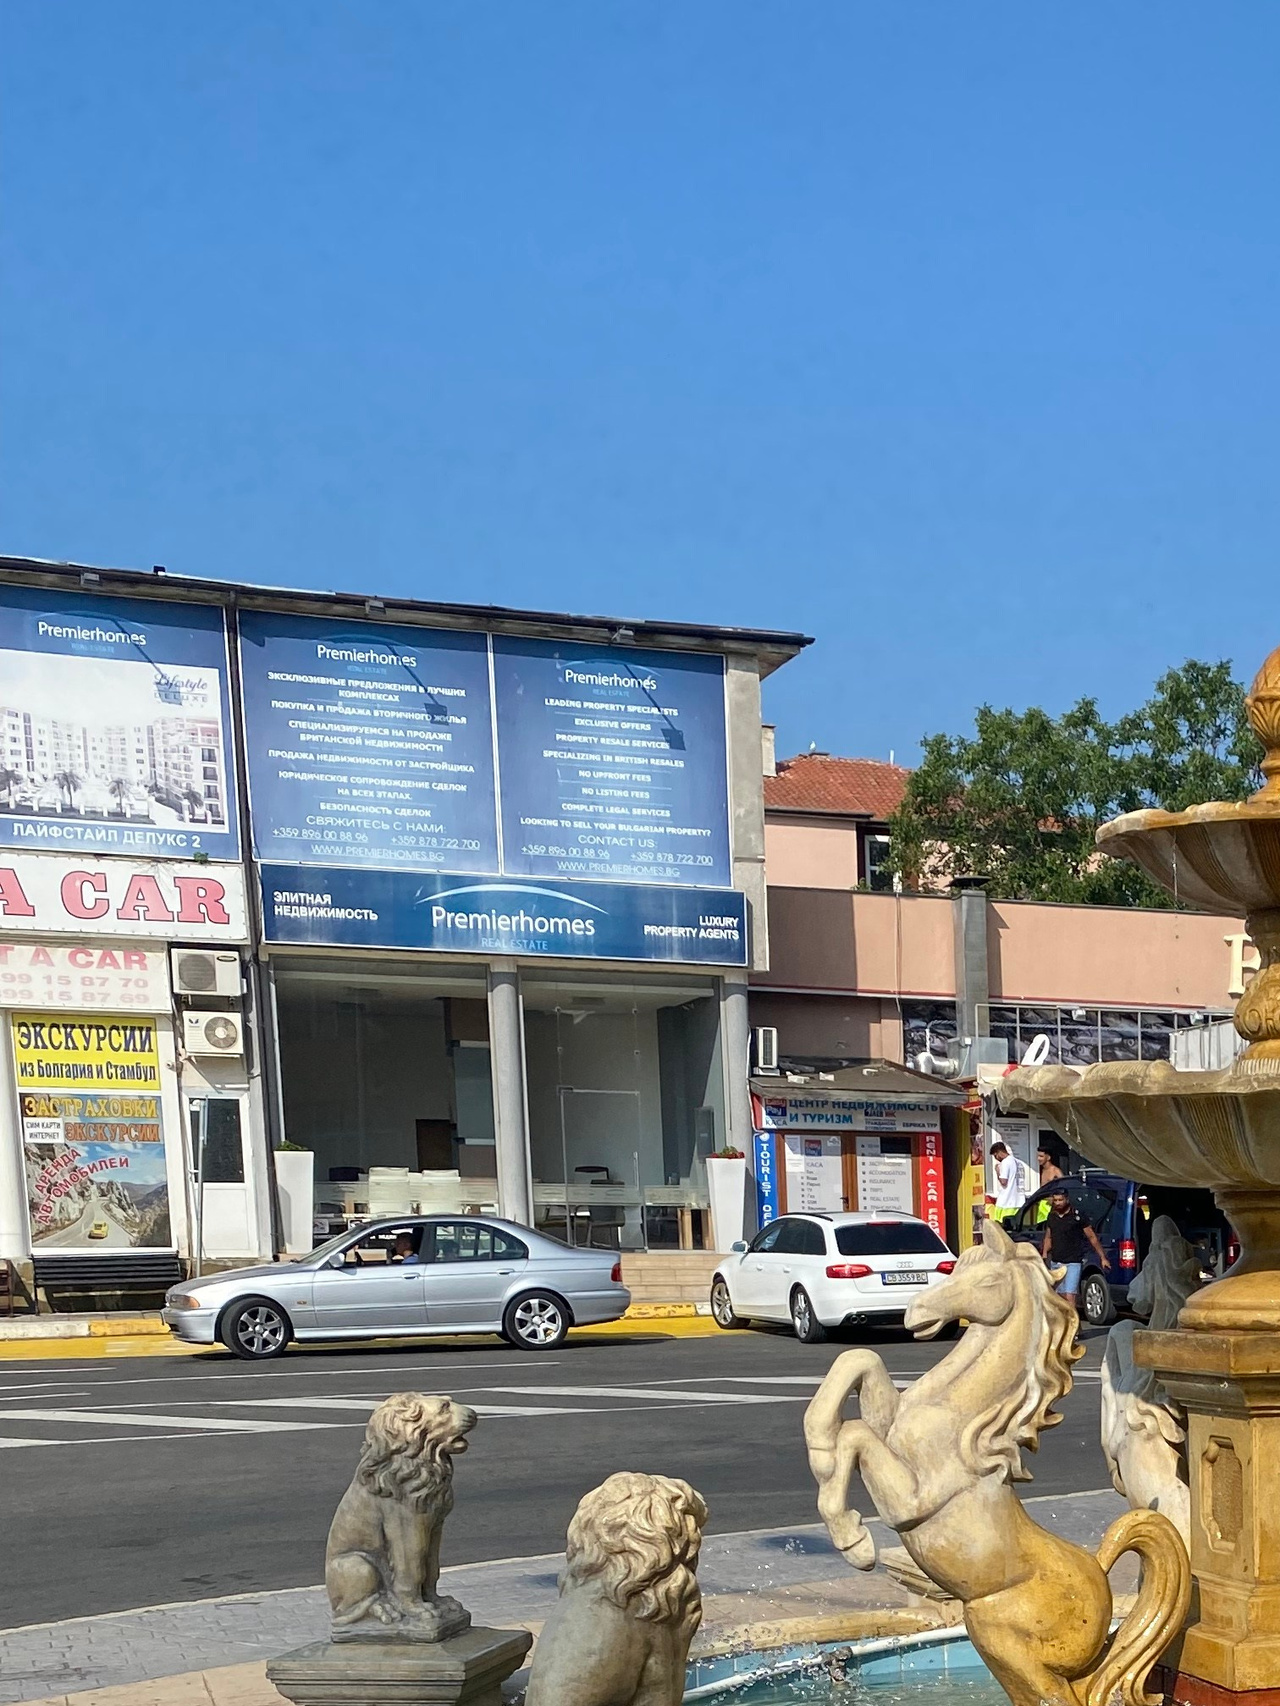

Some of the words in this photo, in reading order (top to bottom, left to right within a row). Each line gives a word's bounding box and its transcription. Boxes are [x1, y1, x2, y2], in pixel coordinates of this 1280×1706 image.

[38, 621, 147, 645] Premierhomes
[316, 644, 417, 668] Premierhomes
[268, 671, 346, 687] ЭКСКЛЮЗИВНЫЕ
[348, 679, 417, 693] ПРЕДЛОЖЕНИЯ
[426, 686, 466, 697] ЛУЧШИХ
[565, 669, 657, 691] Premierhomes
[338, 689, 400, 702] КОМПЛЕКСАХ
[271, 700, 315, 711] ПОКУПКА
[317, 703, 324, 712] И
[326, 705, 371, 717] ПРОДАЖА
[373, 709, 432, 721] ВТОРИЧНОГО
[544, 698, 582, 709] LEADING
[583, 702, 625, 712] PROPERTY
[627, 705, 679, 717] SPECIALISTS
[288, 719, 390, 736] СПЕЦИАЛИЗИРУЕМСЯ
[391, 728, 405, 737] НА
[406, 730, 452, 741] ПРОДАЖЕ
[574, 718, 619, 729] EXCLUSIVE
[620, 721, 651, 731] OFFERS
[299, 733, 363, 746] БРИТАНСКОЙ
[364, 738, 444, 752] НЕДВИЖИМОСТИ
[555, 734, 598, 745] PROPERTY
[600, 737, 630, 747] RESALE
[631, 740, 670, 750] SERVICES
[268, 749, 315, 762] ПРОДАЖА
[316, 753, 393, 767] НЕДВИЖИМОСТИ
[395, 759, 407, 768] ОТ
[408, 760, 475, 774] ЗАСТРОЙЩИКА
[543, 750, 601, 762] SPECIALIZING
[603, 754, 613, 763] IN
[614, 755, 648, 765] BRITISH
[650, 758, 684, 768] RESALES
[278, 770, 348, 783] ЮРИДИЧЕСКОЕ
[350, 776, 430, 789] СОПРОВОЖДЕНИЕ
[431, 782, 467, 792] СДЕЛОК
[579, 770, 591, 778] NO
[592, 771, 630, 781] UPFRONT
[632, 774, 651, 782] FEES
[337, 787, 350, 796] НА
[352, 788, 375, 798] ВСЕХ
[581, 787, 594, 796] NO
[595, 788, 629, 798] LISTING
[630, 790, 650, 799] FEES
[320, 802, 393, 815] БЕЗОПАСНОСТЬ
[394, 808, 432, 818] СДЕЛОК
[561, 803, 603, 813] COMPLETE
[605, 806, 630, 815] LEGAL
[632, 807, 670, 818] SERVICES
[306, 815, 390, 830] СВЯЖИТЕСЬ
[393, 821, 403, 831] С
[406, 823, 447, 834] НАМИ:
[520, 817, 558, 827] LOOKING
[560, 819, 571, 828] TO
[573, 820, 592, 829] SELL
[593, 821, 616, 831] YOUR
[618, 823, 664, 834] BULGARIAN
[665, 826, 711, 837] PROPERTY?
[13, 822, 118, 842] ЛАЙФСТАЙЛ
[123, 831, 187, 848] ДЕЛУКС
[191, 835, 201, 848] 2
[577, 834, 636, 847] CONTACT
[638, 837, 658, 848] US:
[311, 843, 445, 862] WWW.PREMIERHOMES.BG
[556, 861, 680, 878] WWW.PREMIERHOMES.BG
[0, 867, 36, 917] A
[60, 870, 230, 925] CAR
[273, 890, 332, 905] ЭЛИТНАЯ
[274, 904, 379, 921] НЕДВИЖИМОСТЬ
[431, 905, 595, 936] Premierhomes
[699, 915, 739, 928] LUXURY
[643, 925, 698, 939] PROPERTY
[699, 927, 740, 940] AGENTS
[481, 937, 507, 949] REAL
[510, 938, 548, 951] ESTATE
[28, 946, 55, 968] A
[68, 947, 148, 971] CAR
[42, 974, 71, 985] 15
[80, 976, 109, 987] 87
[118, 977, 148, 989] 70
[44, 990, 72, 1001] 15
[82, 991, 110, 1002] 87
[120, 993, 150, 1004] 69
[17, 1021, 154, 1053] ЭКСКУРСИИ
[20, 1062, 34, 1078] из
[37, 1059, 93, 1082] Болгария
[95, 1064, 104, 1079] и
[106, 1061, 156, 1082] Стамбул
[24, 1096, 158, 1119] ЗАСТРАХОВКИ
[789, 1099, 828, 1110] ЦЕНТР
[832, 1100, 938, 1112] НЕДВИЖИМОСТЬ
[766, 1118, 788, 1126] КАСА
[789, 1113, 799, 1122] И
[802, 1114, 853, 1124] ТУРИЗМ
[64, 1122, 161, 1143] ЭКСКУРСИИ
[926, 1136, 936, 1162] RENT
[34, 1148, 82, 1195] АРЕНДА
[760, 1143, 771, 1197] TOURIST
[926, 1168, 938, 1176] A
[37, 1155, 130, 1226] АВТОМОБИЛЕЙ
[927, 1182, 938, 1202] CAR
